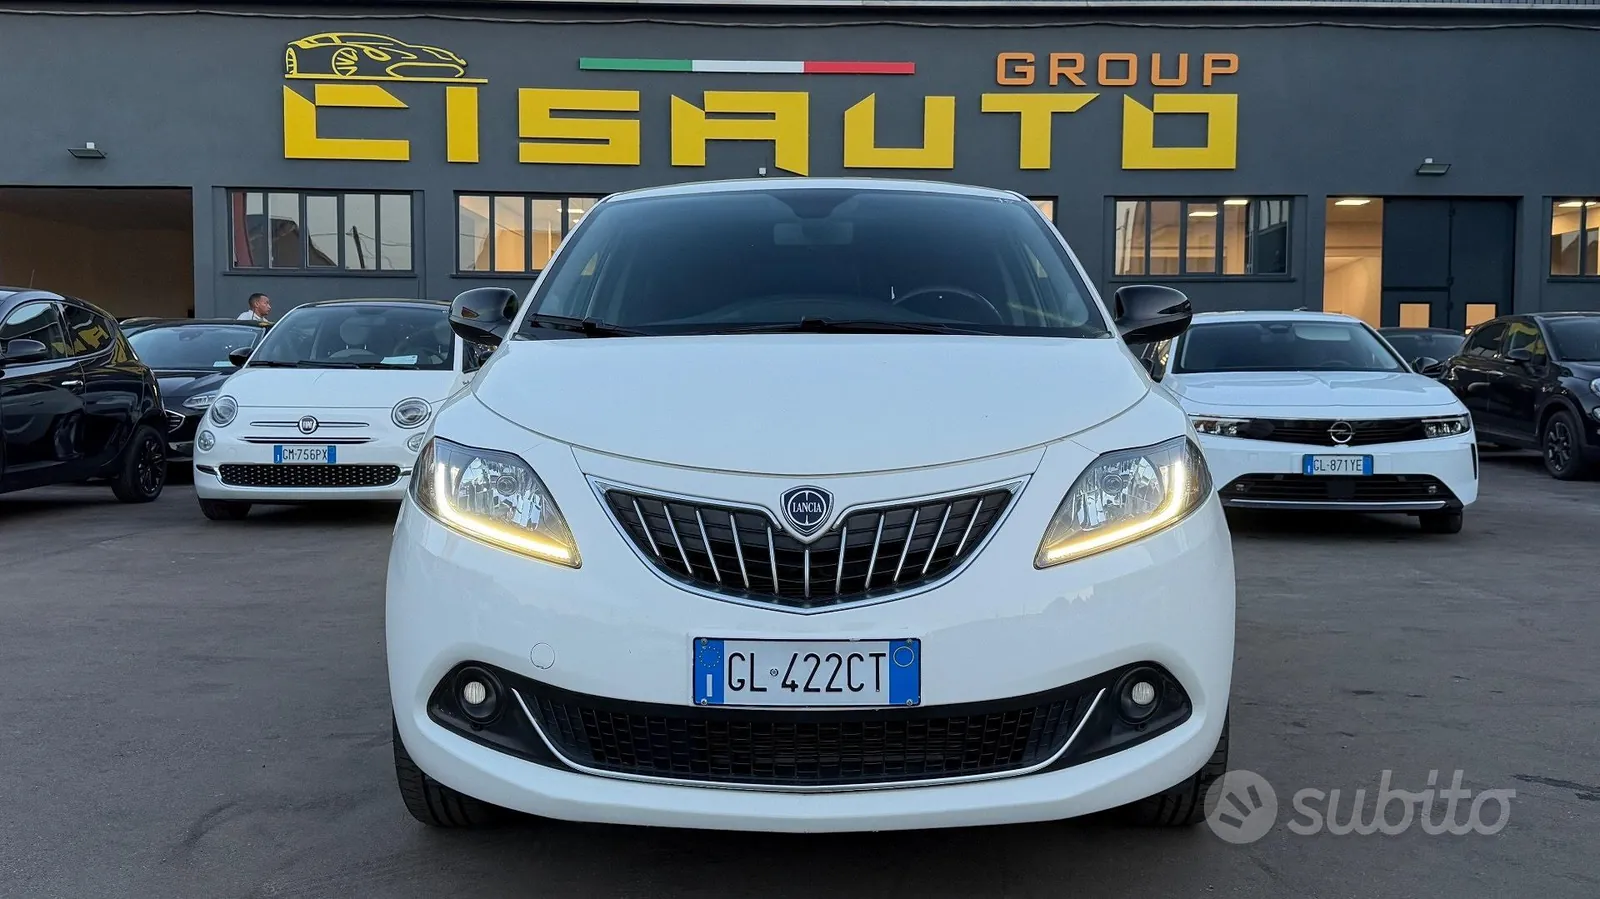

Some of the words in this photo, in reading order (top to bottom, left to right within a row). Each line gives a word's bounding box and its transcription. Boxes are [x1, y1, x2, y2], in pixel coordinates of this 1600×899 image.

[996, 52, 1240, 86] GROUP
[283, 83, 1239, 177] CISAUTO
[792, 502, 822, 513] LANCIA
